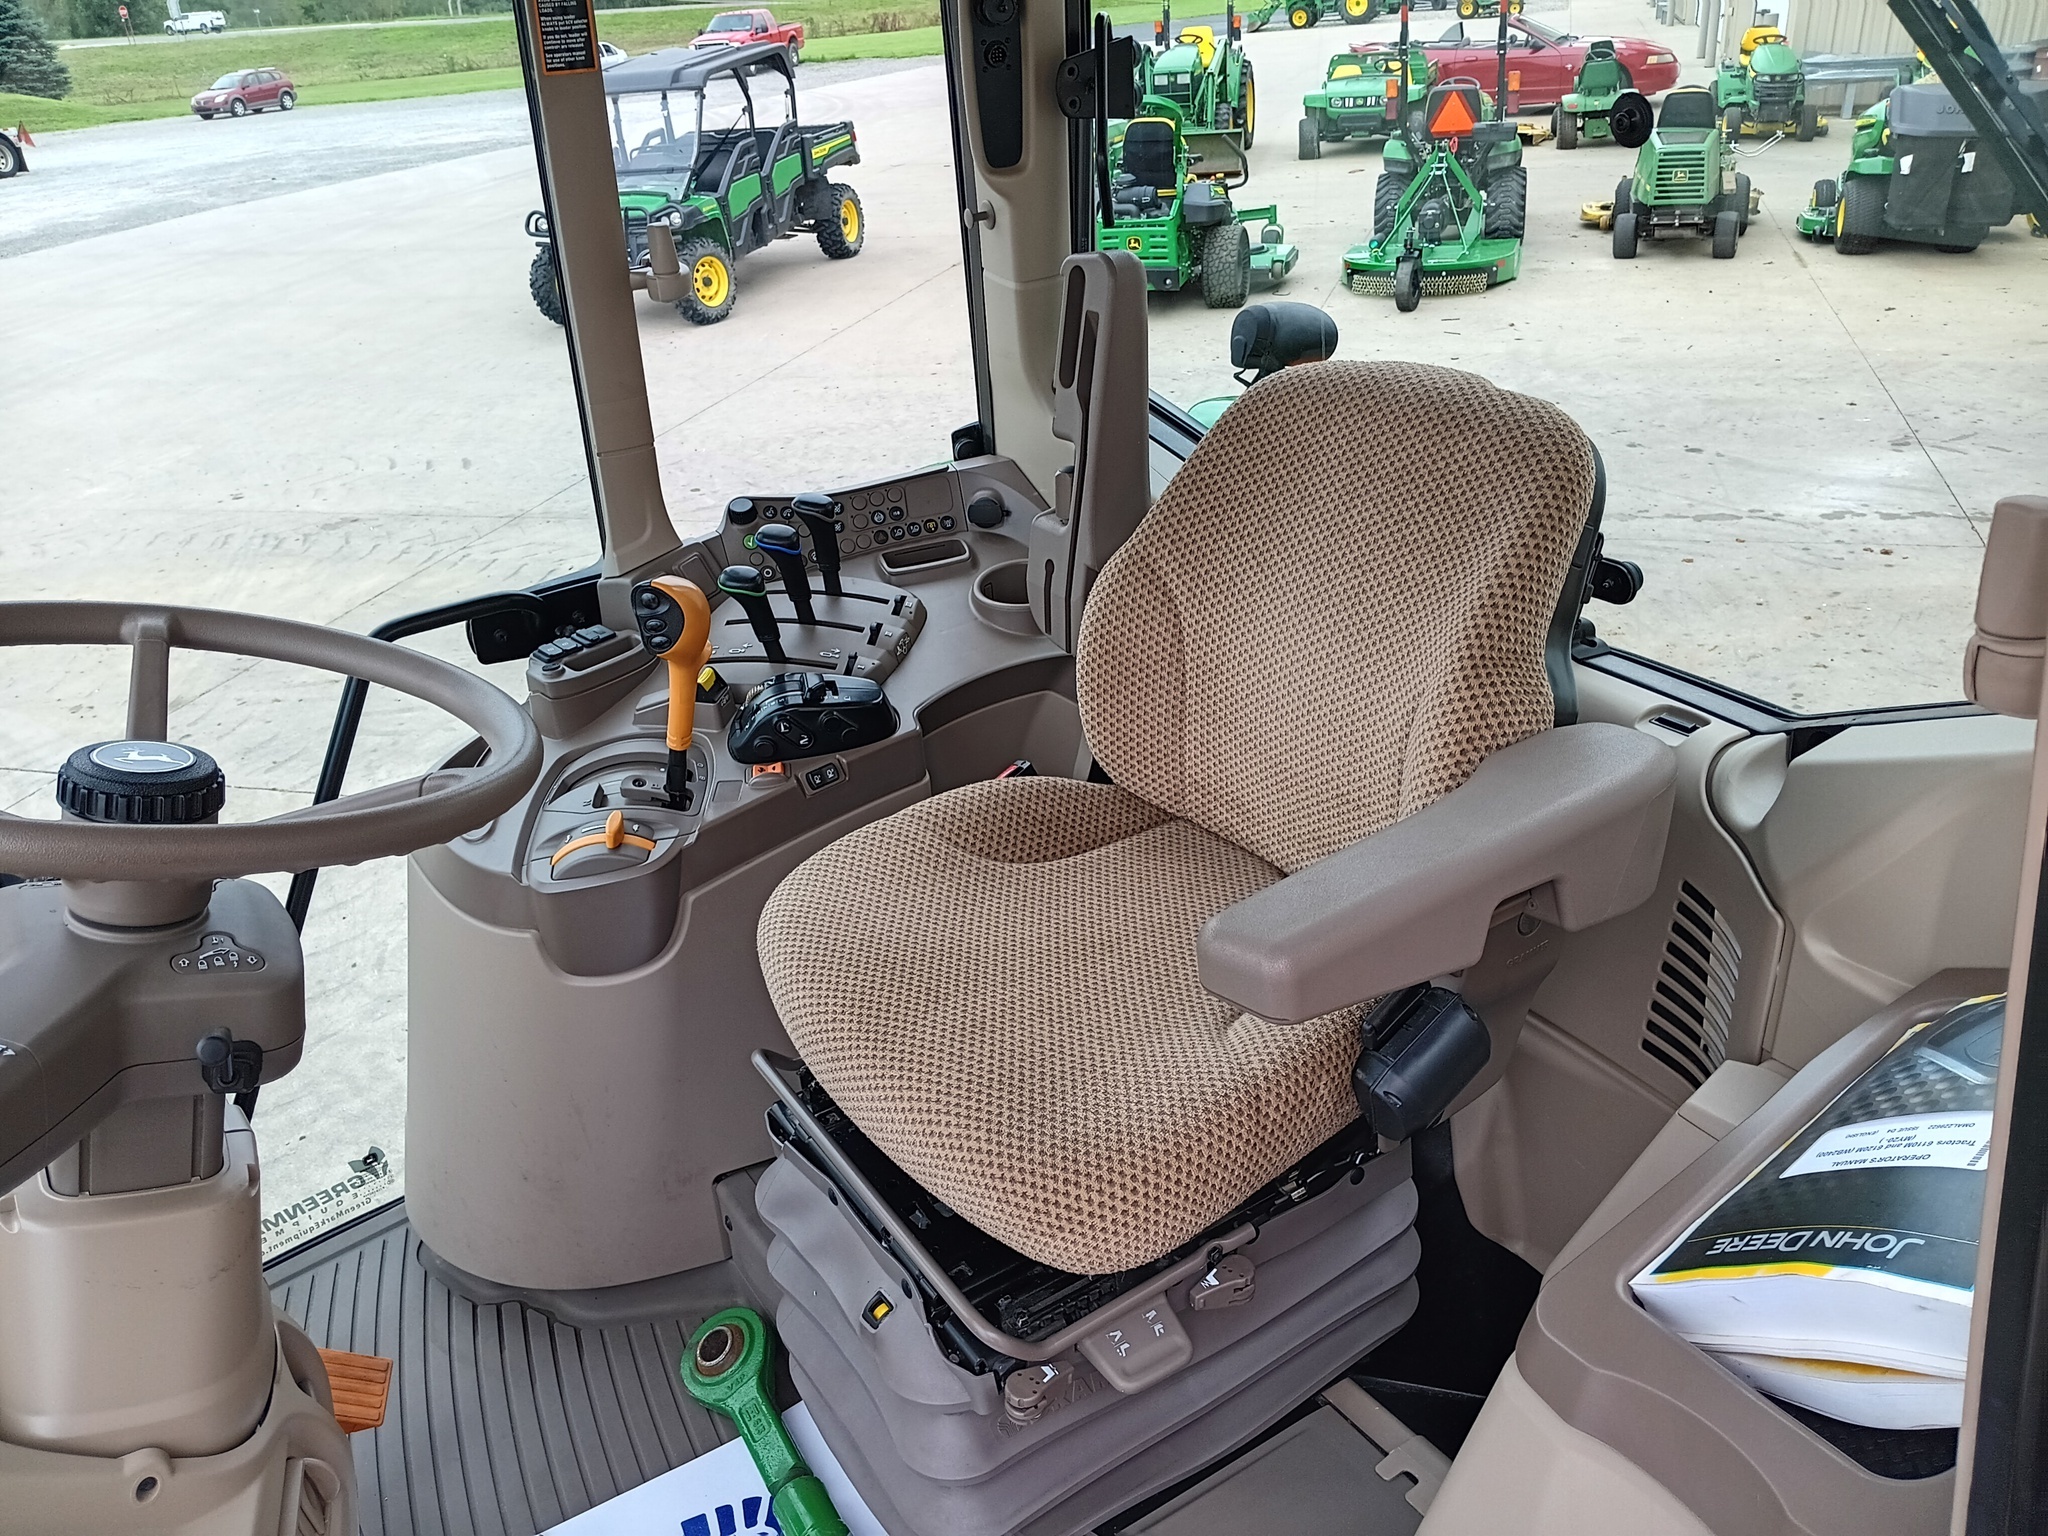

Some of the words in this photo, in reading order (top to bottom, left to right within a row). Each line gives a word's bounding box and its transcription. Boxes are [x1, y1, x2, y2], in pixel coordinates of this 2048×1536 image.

[1904, 1140, 1936, 1149] 6110M
[1936, 1139, 1977, 1148] Tractors
[1855, 1145, 1883, 1154] 6120M
[1832, 1158, 1868, 1167] MANUAL
[1869, 1153, 1931, 1164] OPERATOR'S
[1705, 1231, 1814, 1256] DEERE
[1810, 1231, 1926, 1259] JOHN
